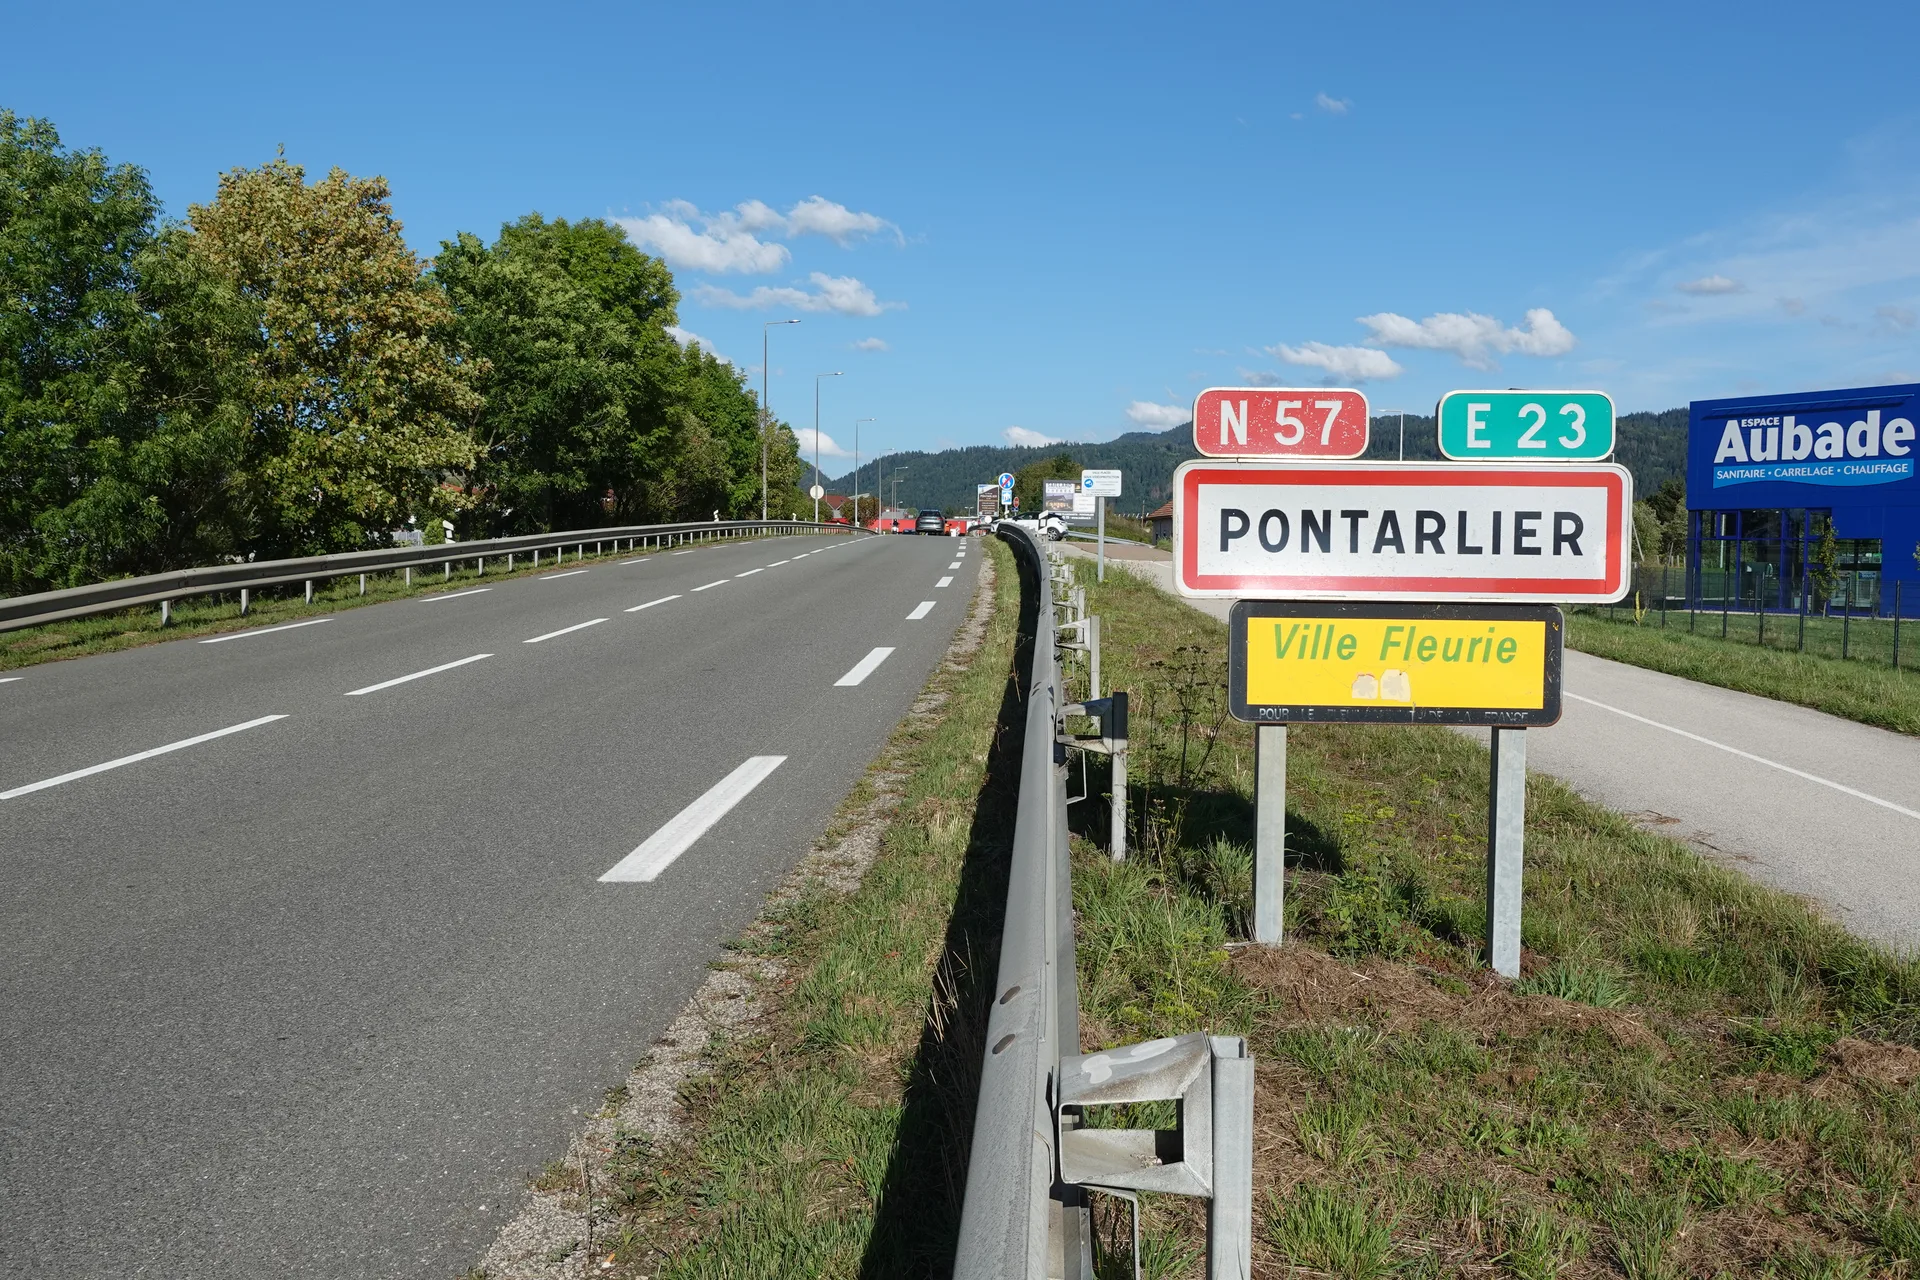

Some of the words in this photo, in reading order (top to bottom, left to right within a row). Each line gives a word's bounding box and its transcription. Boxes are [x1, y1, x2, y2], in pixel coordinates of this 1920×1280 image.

[1219, 399, 1248, 446] N
[1273, 398, 1343, 446] 57
[1466, 403, 1492, 449] E
[1517, 402, 1587, 449] 23
[1713, 409, 1916, 463] Aubade
[1740, 417, 1780, 428] ESPACE
[1716, 468, 1767, 480] SANITAIRE
[1774, 465, 1835, 478] CARRELAGE
[1843, 463, 1909, 475] CHAUFFAGE
[1219, 507, 1584, 556] PONTARLIER
[1274, 622, 1358, 661] Ville
[1379, 625, 1518, 664] Fleurie
[1259, 708, 1290, 720] POUR
